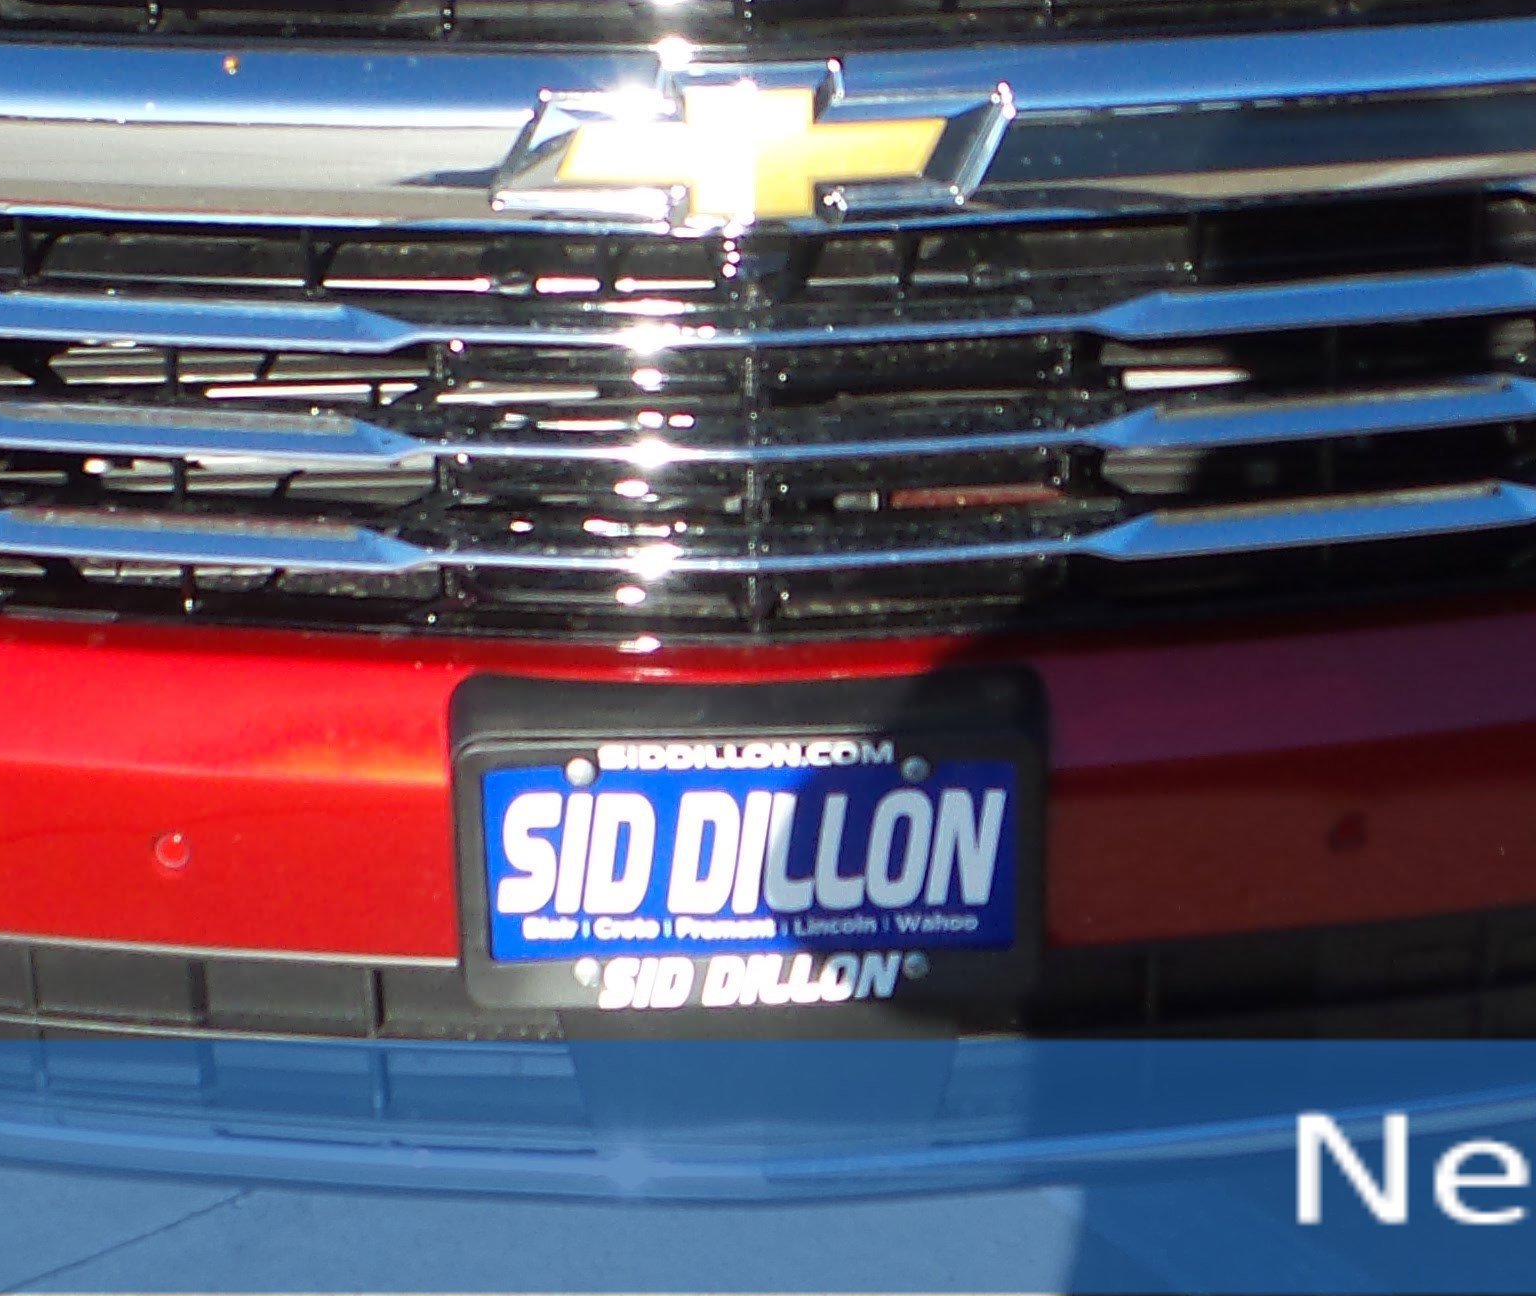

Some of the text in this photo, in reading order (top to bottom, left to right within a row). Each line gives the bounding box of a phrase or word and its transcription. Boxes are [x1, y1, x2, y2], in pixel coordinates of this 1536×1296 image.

[598, 741, 894, 771] SIDDILLON.COM
[497, 789, 1006, 915] SID DILLON
[598, 951, 902, 1009] SID DILLON
